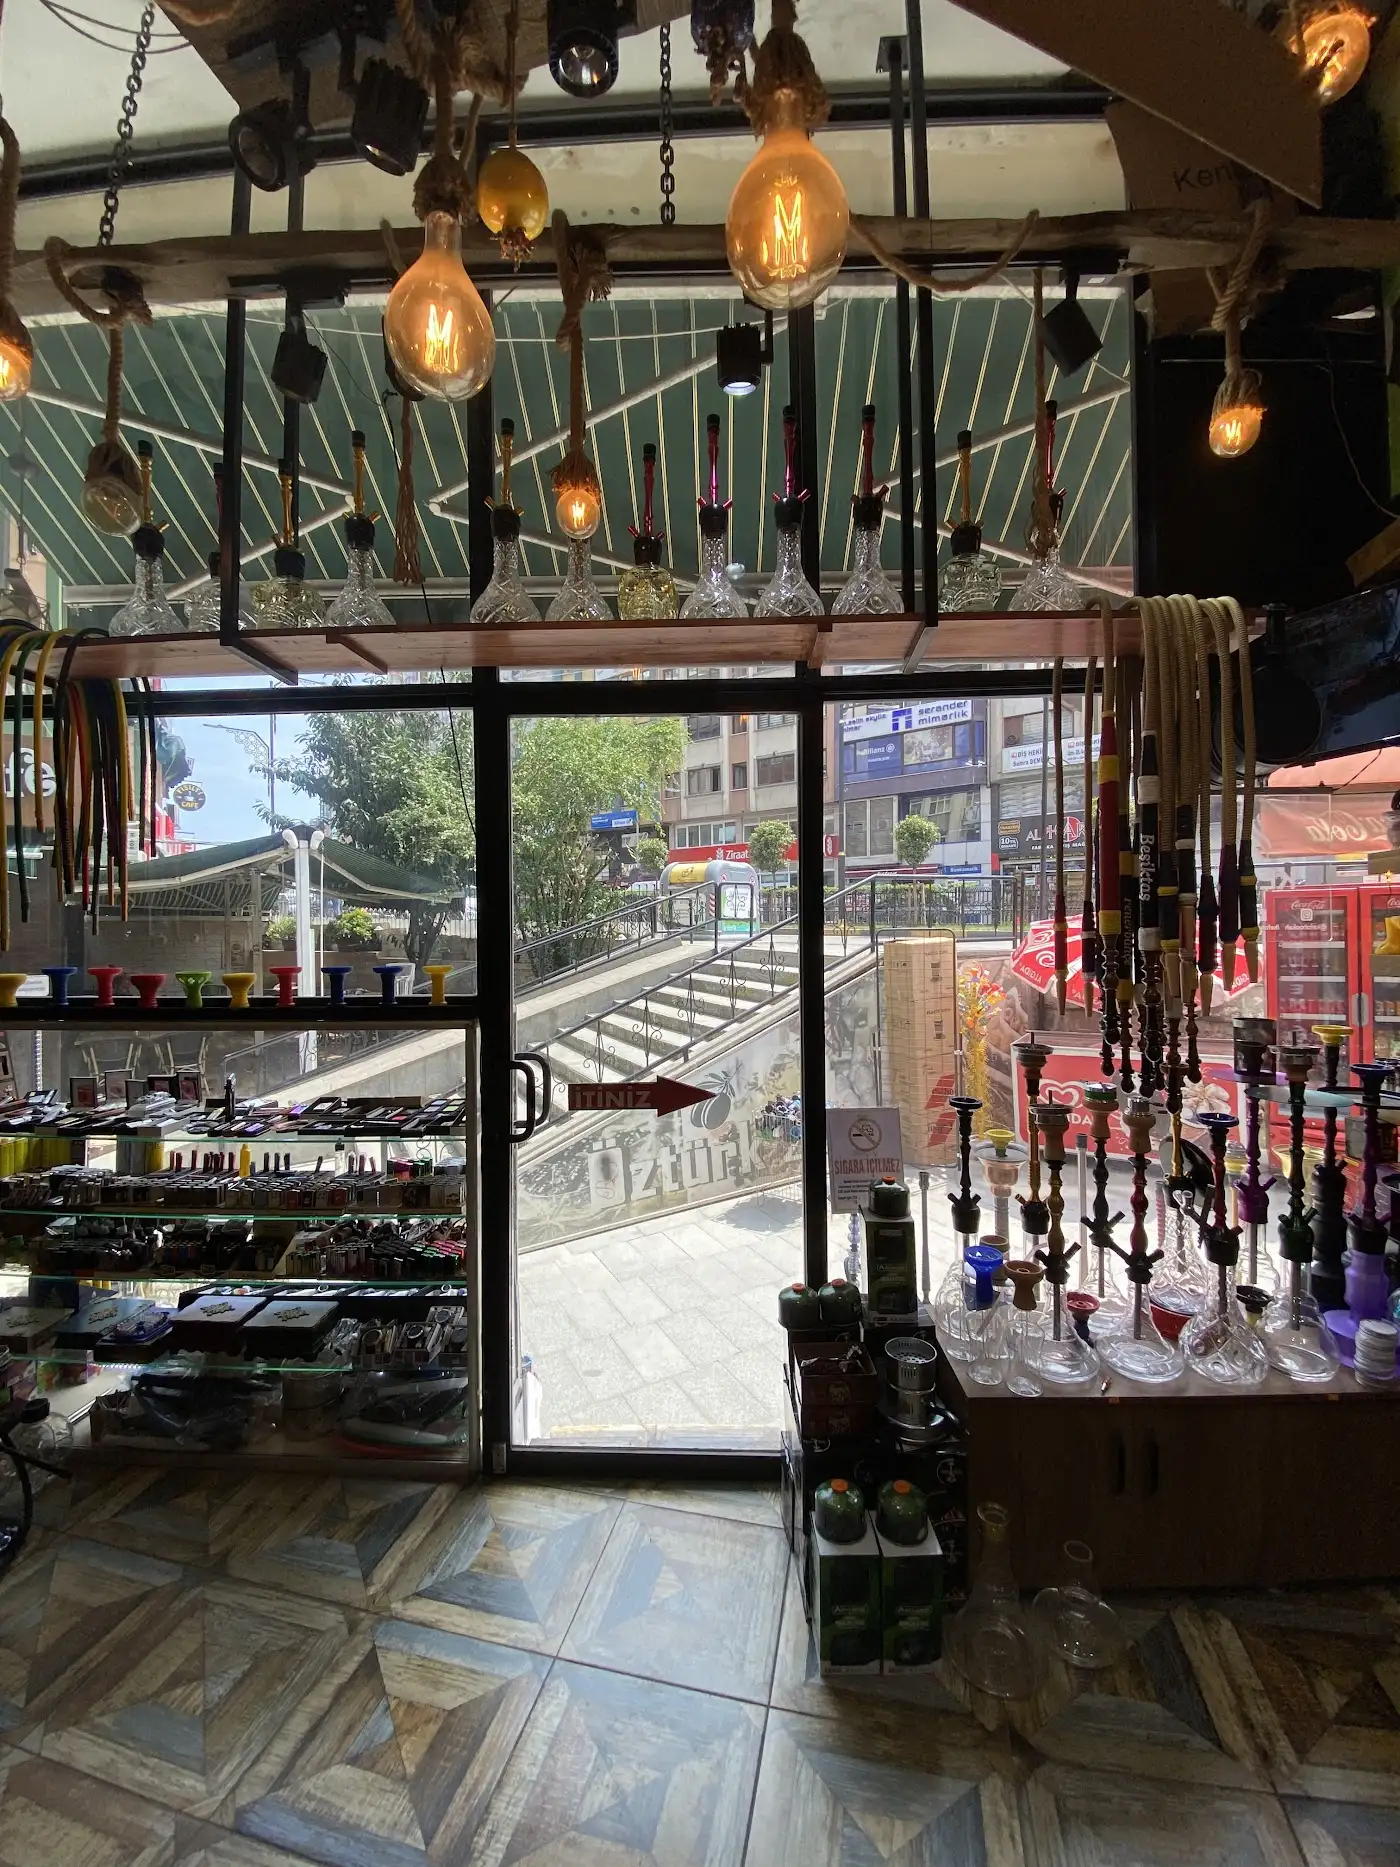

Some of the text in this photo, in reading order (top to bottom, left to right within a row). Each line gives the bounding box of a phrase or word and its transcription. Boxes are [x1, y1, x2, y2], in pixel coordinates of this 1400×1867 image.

[918, 699, 968, 716] serander
[3, 747, 57, 797] fe
[725, 849, 749, 860] Ziraat
[1290, 900, 1326, 911] Coca-Cola
[575, 1085, 652, 1109] İTİNİZ
[588, 1120, 766, 1210] Öztürk
[866, 1154, 901, 1177] İÇİLMEZ
